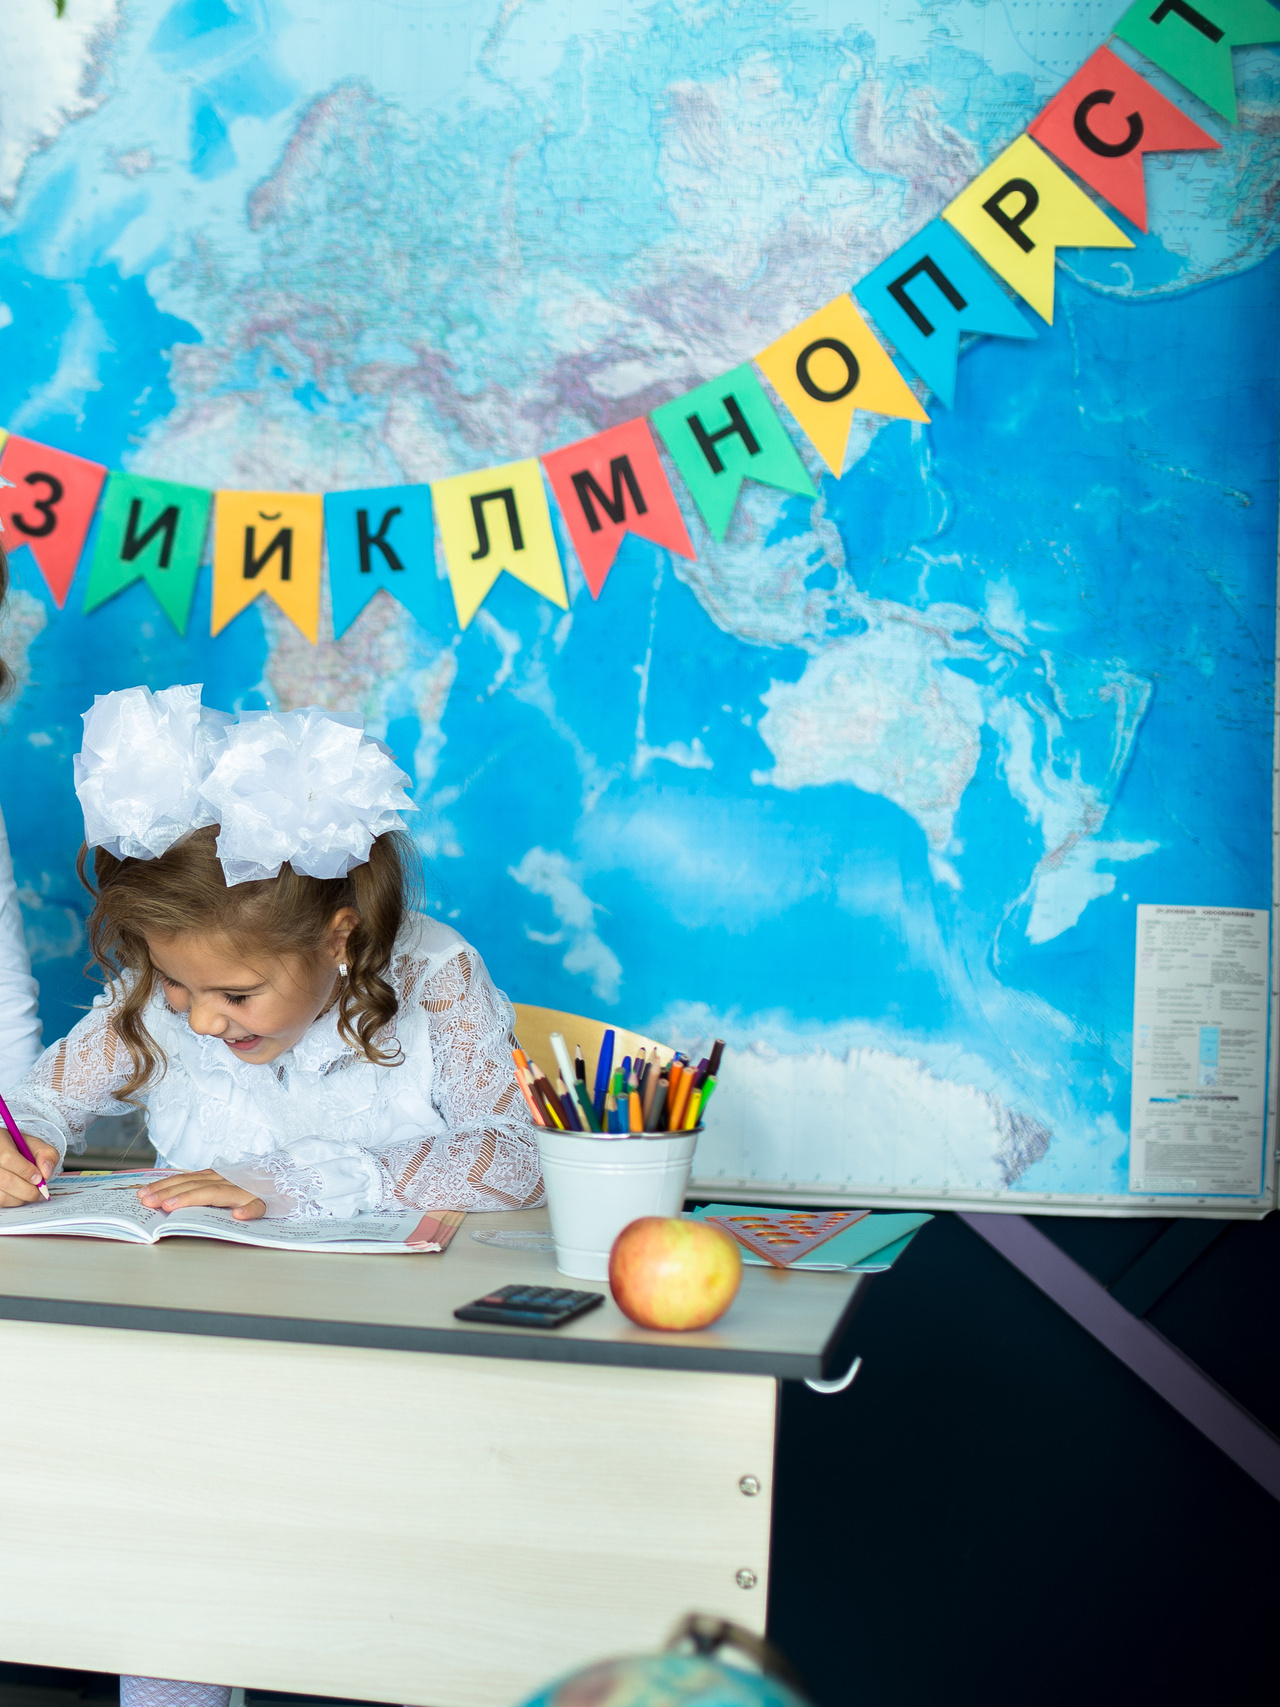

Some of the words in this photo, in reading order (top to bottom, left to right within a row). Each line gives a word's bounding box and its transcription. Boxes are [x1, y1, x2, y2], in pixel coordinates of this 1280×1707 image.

[1074, 90, 1143, 157] С
[982, 179, 1038, 253] Р
[887, 255, 967, 337] П
[796, 339, 859, 402] О
[687, 396, 760, 473] Н
[12, 473, 62, 537] З
[471, 489, 523, 559] Л
[571, 455, 647, 532] М
[121, 499, 179, 568] И
[244, 511, 292, 580] Й
[357, 508, 403, 573] К
